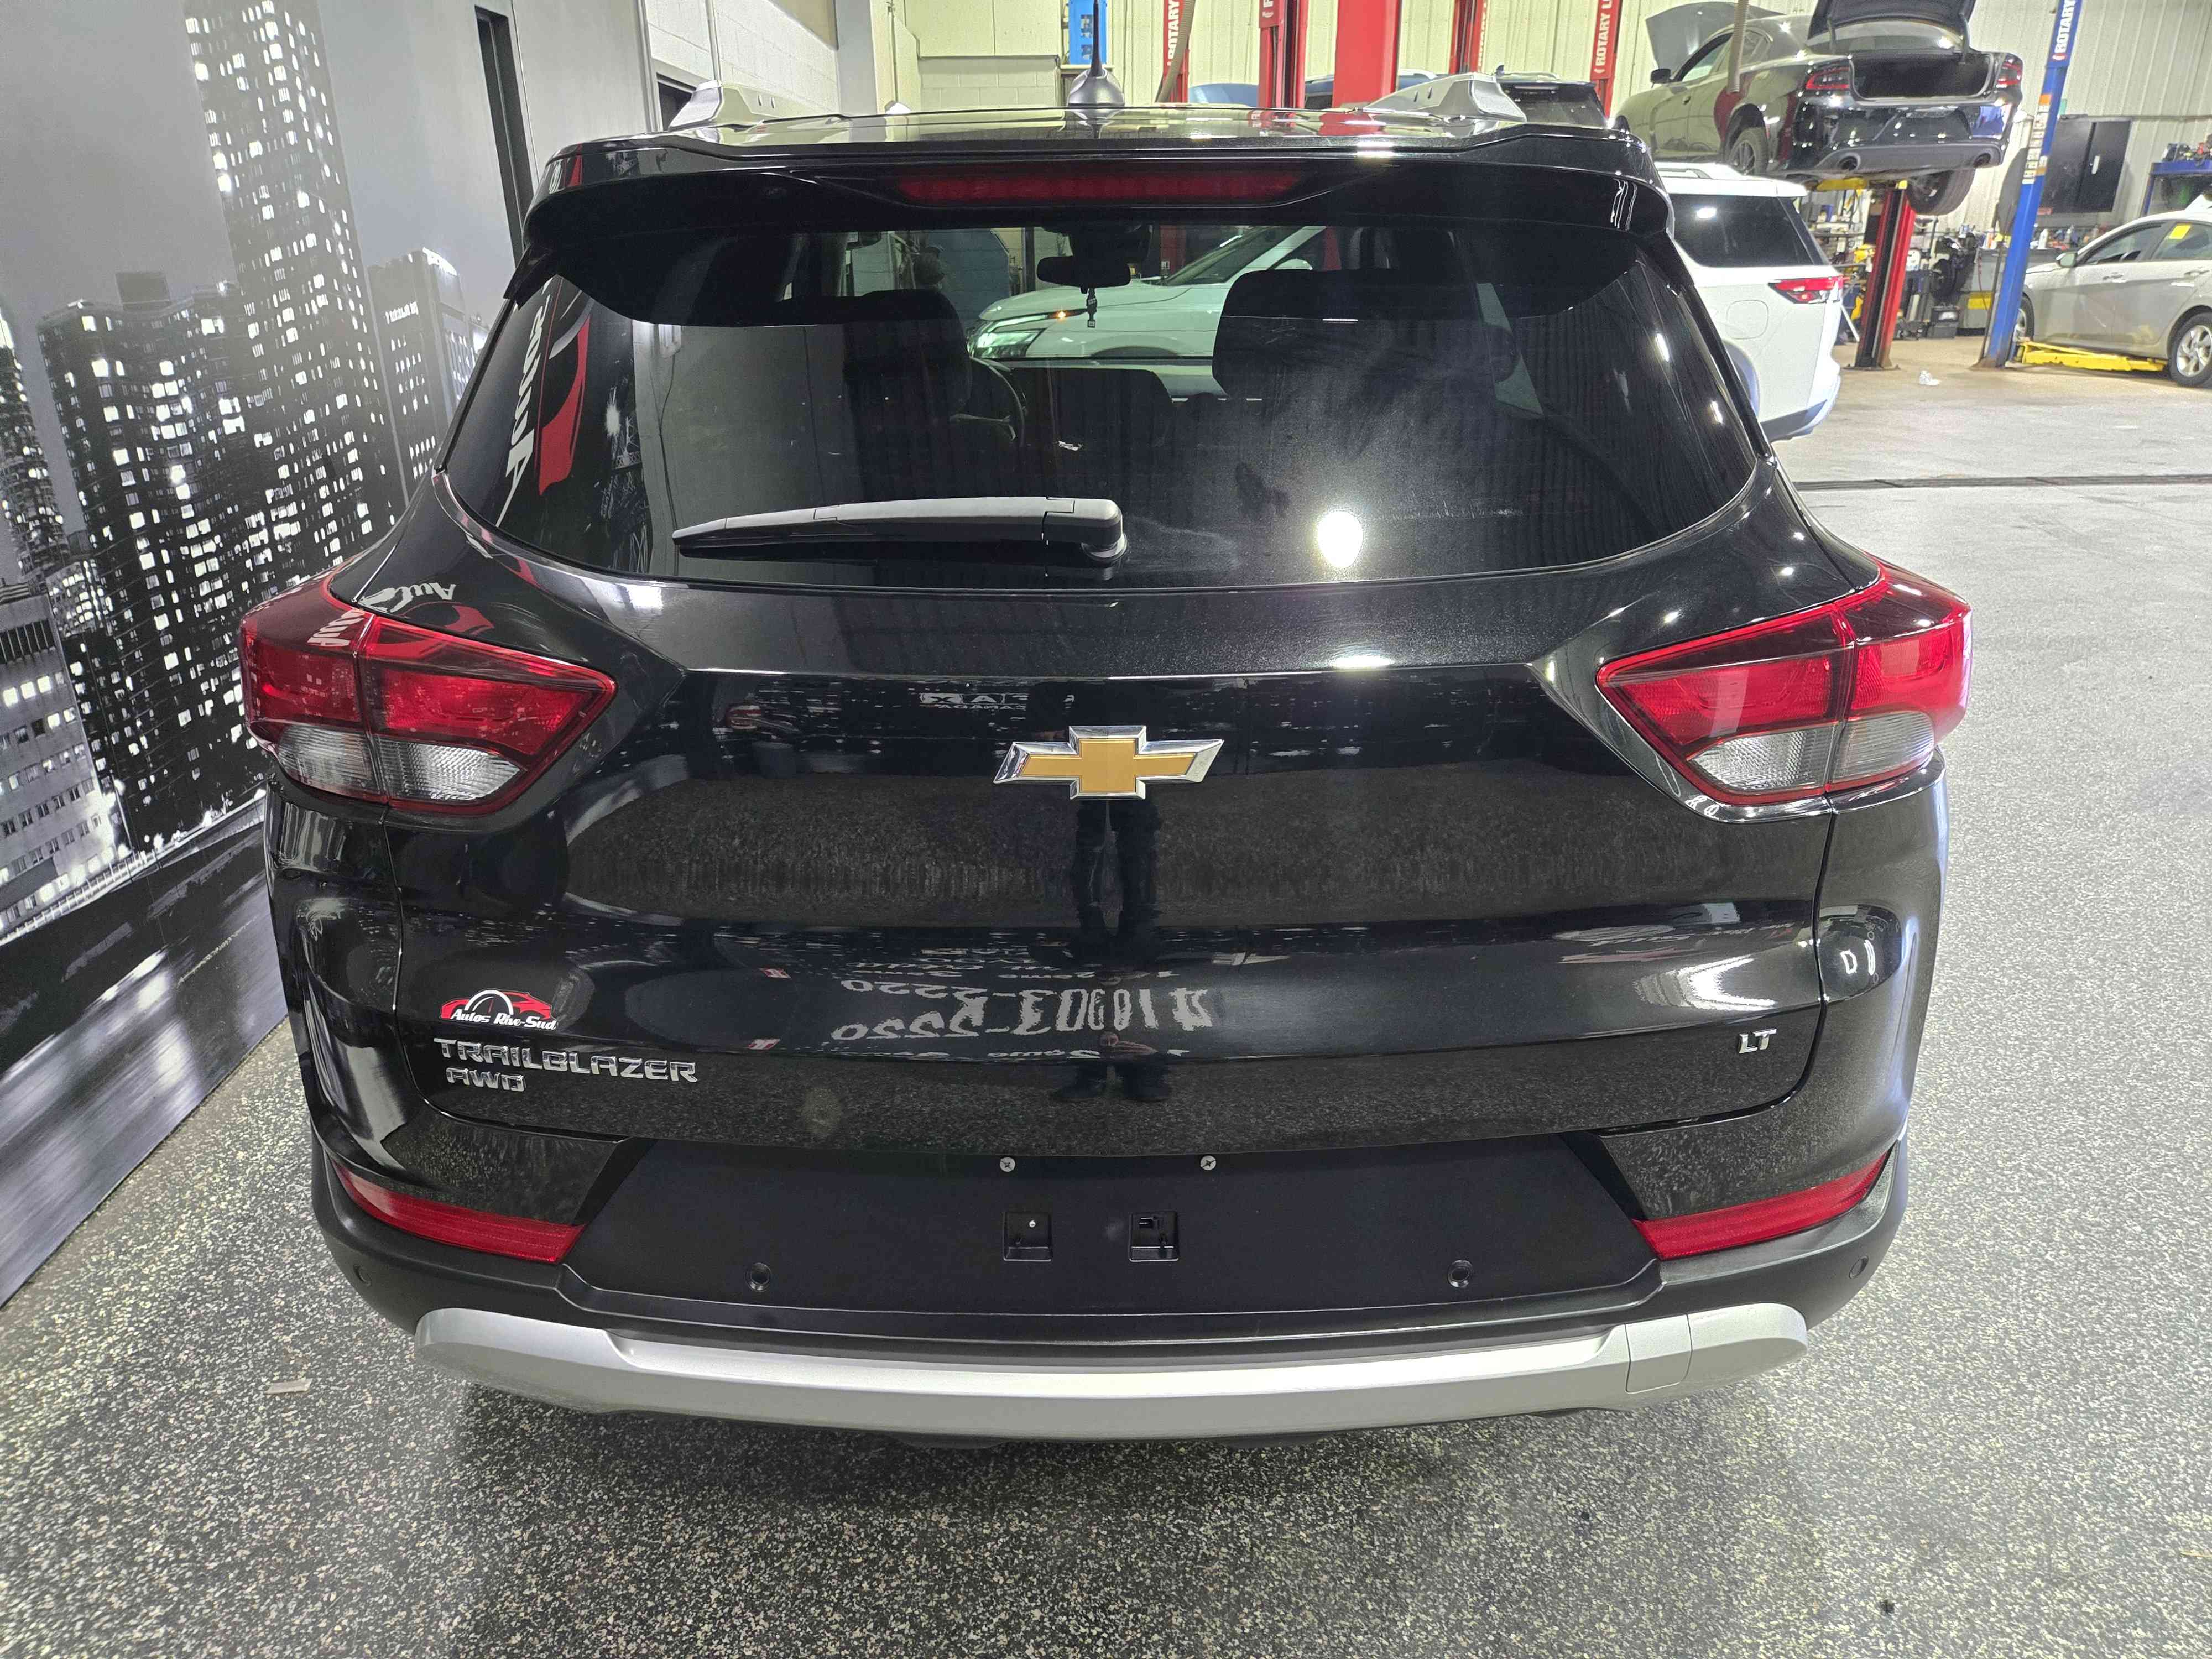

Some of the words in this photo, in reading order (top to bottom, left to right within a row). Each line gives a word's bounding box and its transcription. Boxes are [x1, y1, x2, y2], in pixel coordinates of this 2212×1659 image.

[1595, 12, 1611, 66] ROTARY
[2054, 0, 2077, 53] ROTARY
[451, 1008, 490, 1024] Autos
[493, 1012, 557, 1030] Rive-Sud
[1738, 1027, 1777, 1054] LT
[433, 1037, 698, 1083] TRAILBLAZER
[445, 1067, 526, 1092] AWD
